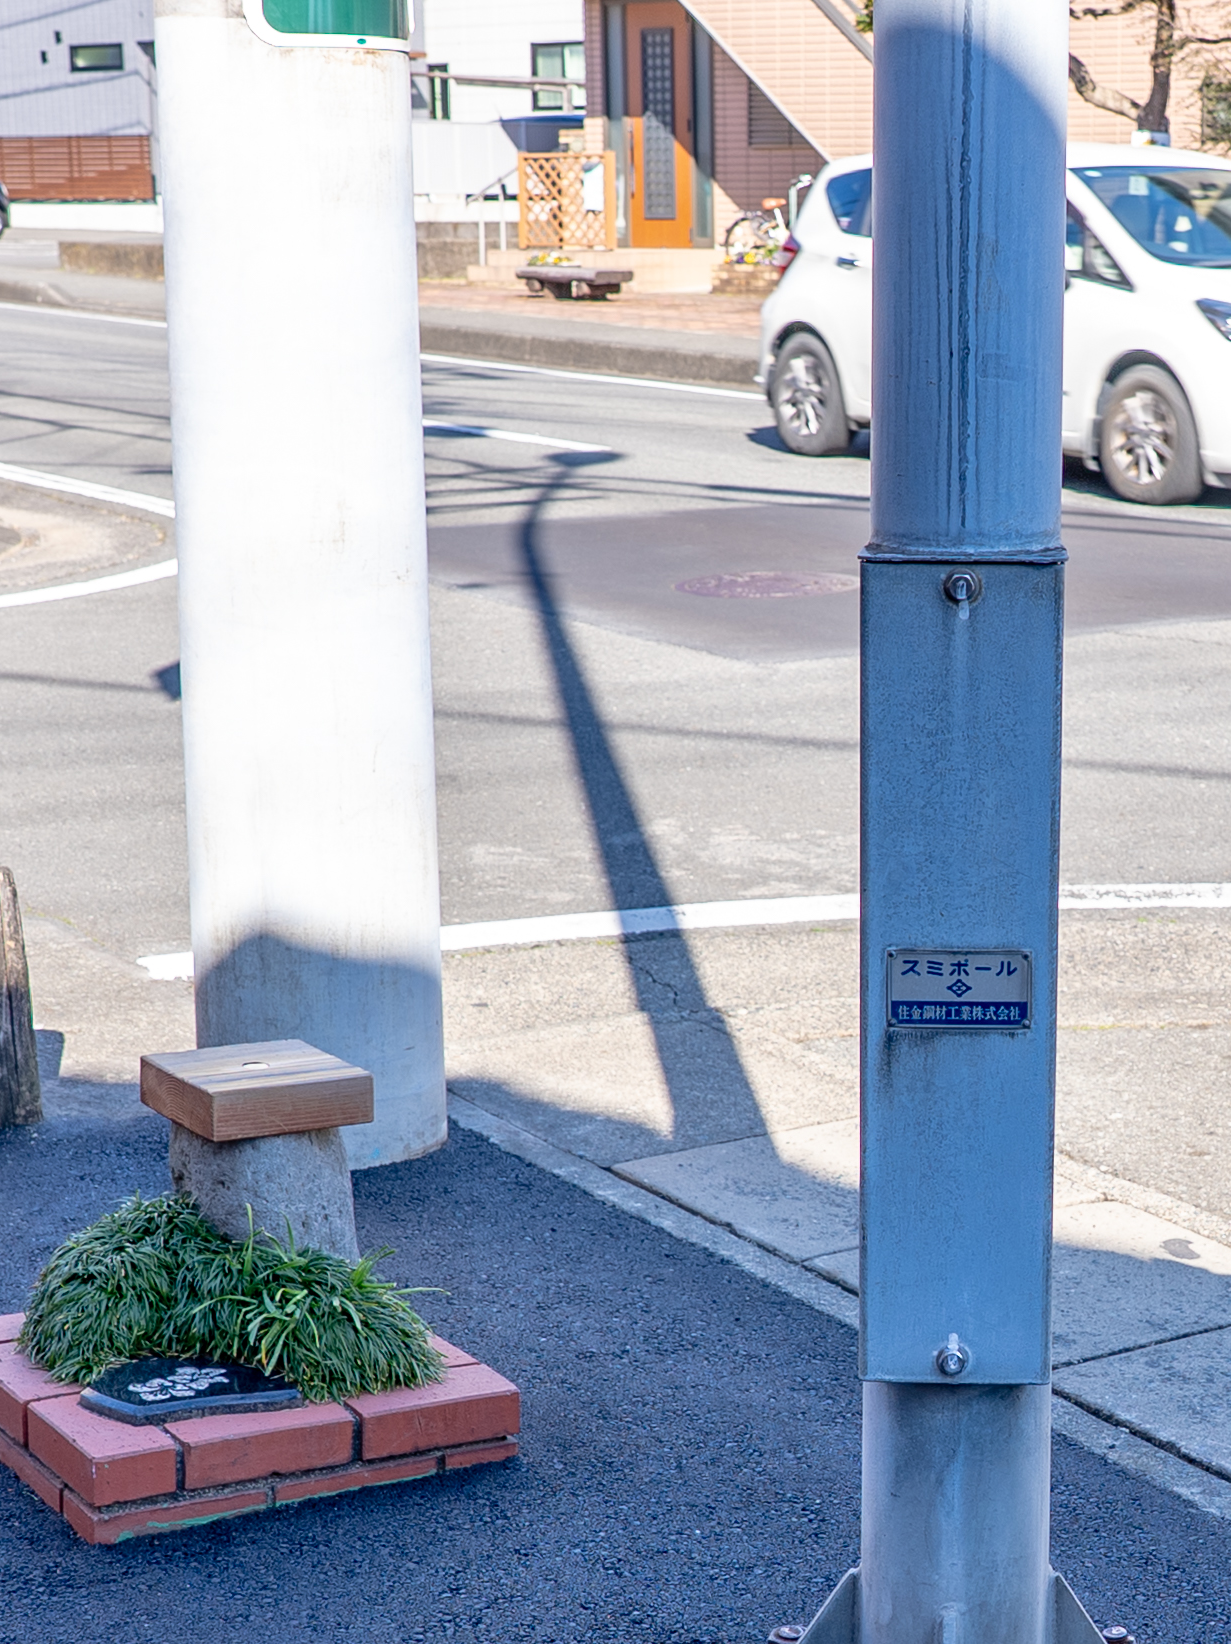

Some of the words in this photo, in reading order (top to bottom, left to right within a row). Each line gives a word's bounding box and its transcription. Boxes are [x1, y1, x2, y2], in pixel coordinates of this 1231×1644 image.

[900, 958, 1018, 977] スミポール
[898, 1004, 1021, 1021] 住金鋼材工業株式会社
